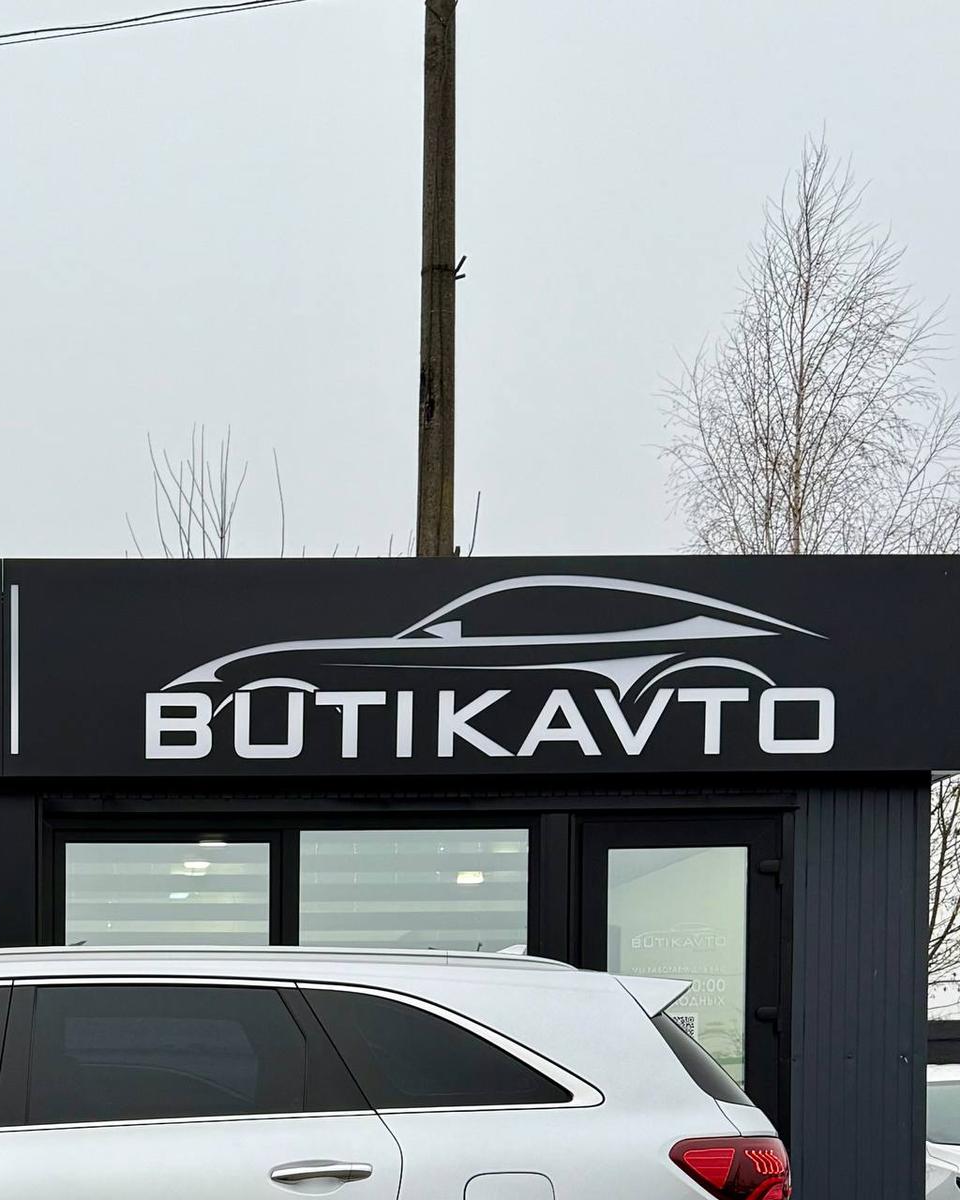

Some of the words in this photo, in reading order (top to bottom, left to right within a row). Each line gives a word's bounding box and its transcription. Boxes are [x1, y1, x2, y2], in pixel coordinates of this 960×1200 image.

[145, 687, 835, 759] BUTIKAVTO
[632, 936, 727, 948] BUTIKAVTO
[692, 978, 726, 992] 0:00
